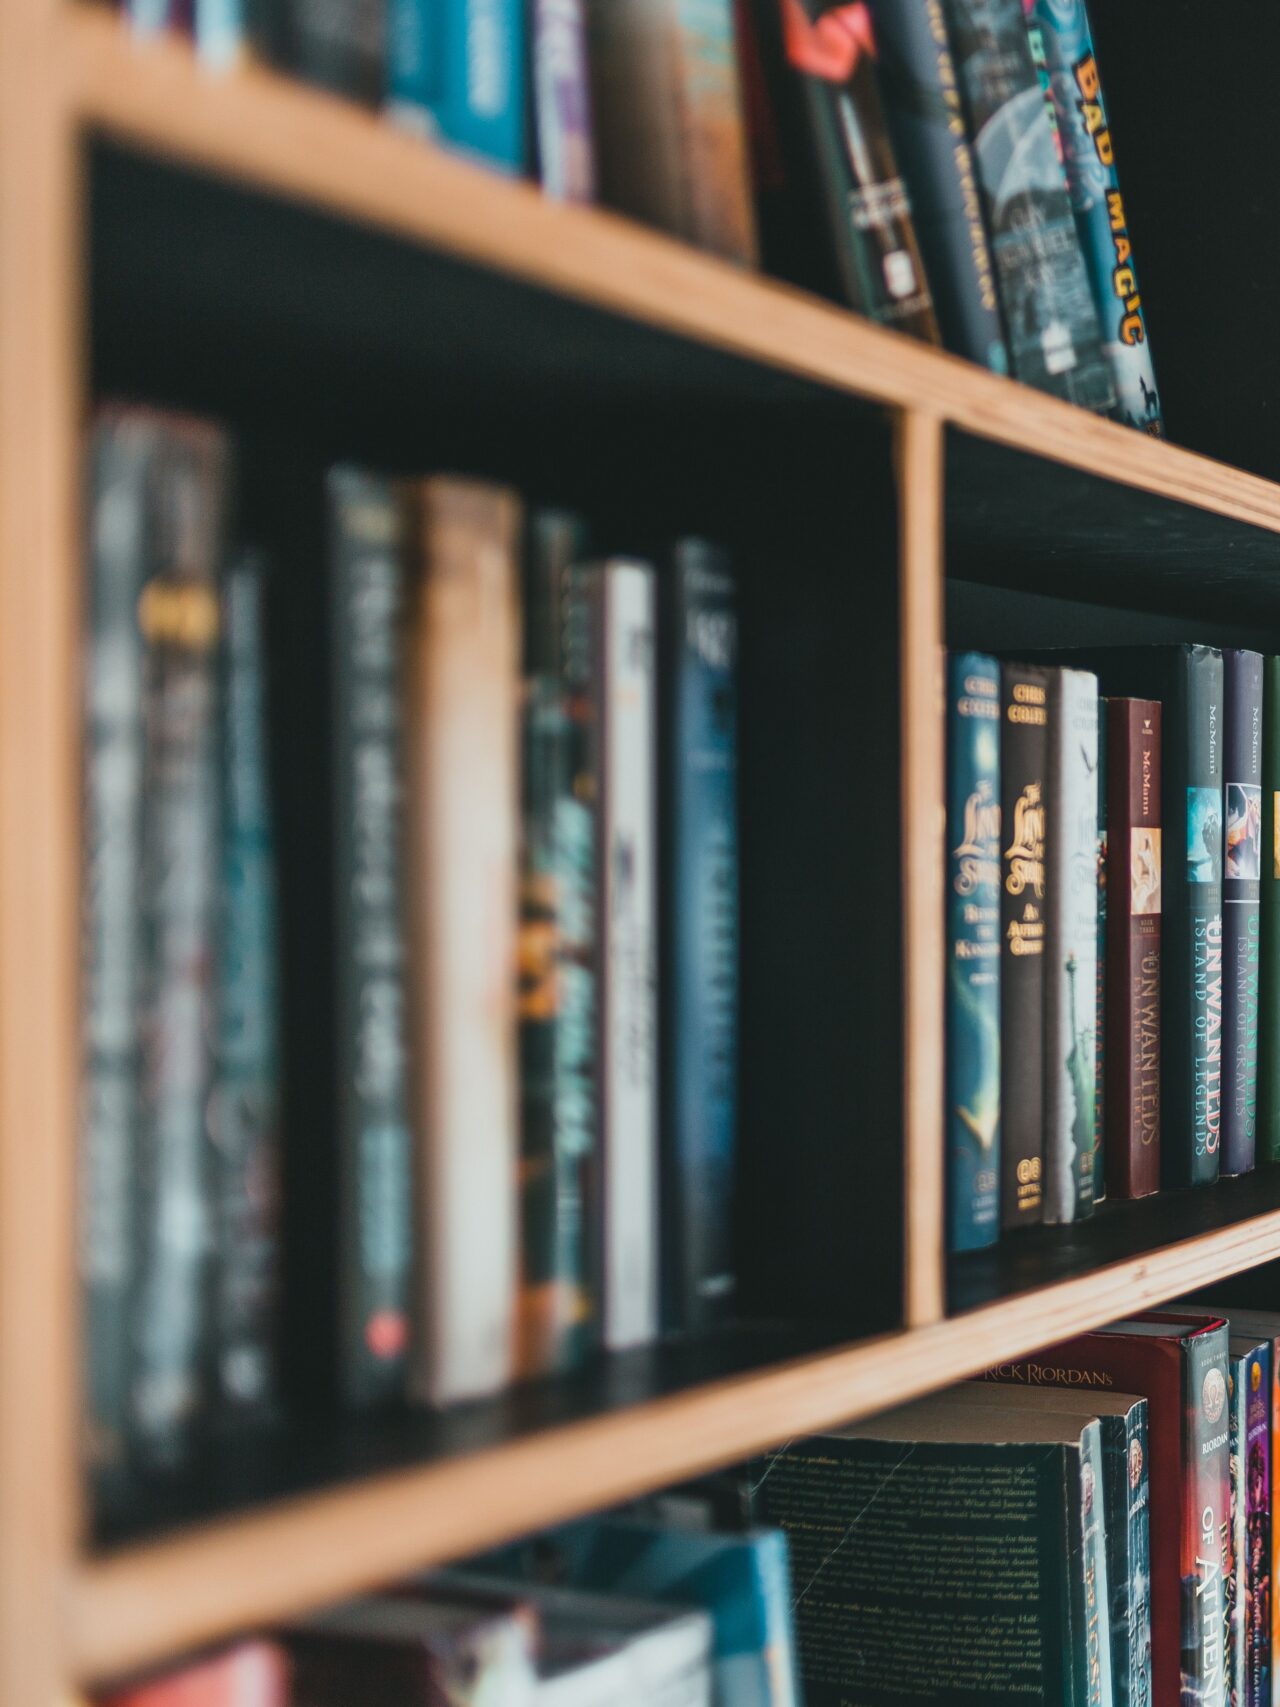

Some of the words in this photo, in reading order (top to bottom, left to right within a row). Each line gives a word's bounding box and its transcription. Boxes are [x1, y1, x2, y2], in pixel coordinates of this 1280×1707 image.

[1072, 55, 1114, 167] BAD
[1106, 190, 1144, 346] MAGIC
[1209, 705, 1217, 775] McMann
[1142, 751, 1151, 816] McMann
[1195, 917, 1206, 1001] ISLAND
[1237, 936, 1247, 1003] ISLAND
[1141, 955, 1160, 1146] UNWANTEDS
[1195, 1015, 1206, 1042] OF
[1205, 918, 1222, 1154] UNWANTEDS
[1237, 1012, 1247, 1036] OF
[1195, 1057, 1206, 1157] LEGENDS
[1236, 1044, 1246, 1117] GRAVES
[985, 1362, 1028, 1382] RICK
[1202, 1431, 1228, 1455] RIORDAN
[1202, 1505, 1215, 1545] OF
[1195, 1555, 1220, 1707] ATHEN
